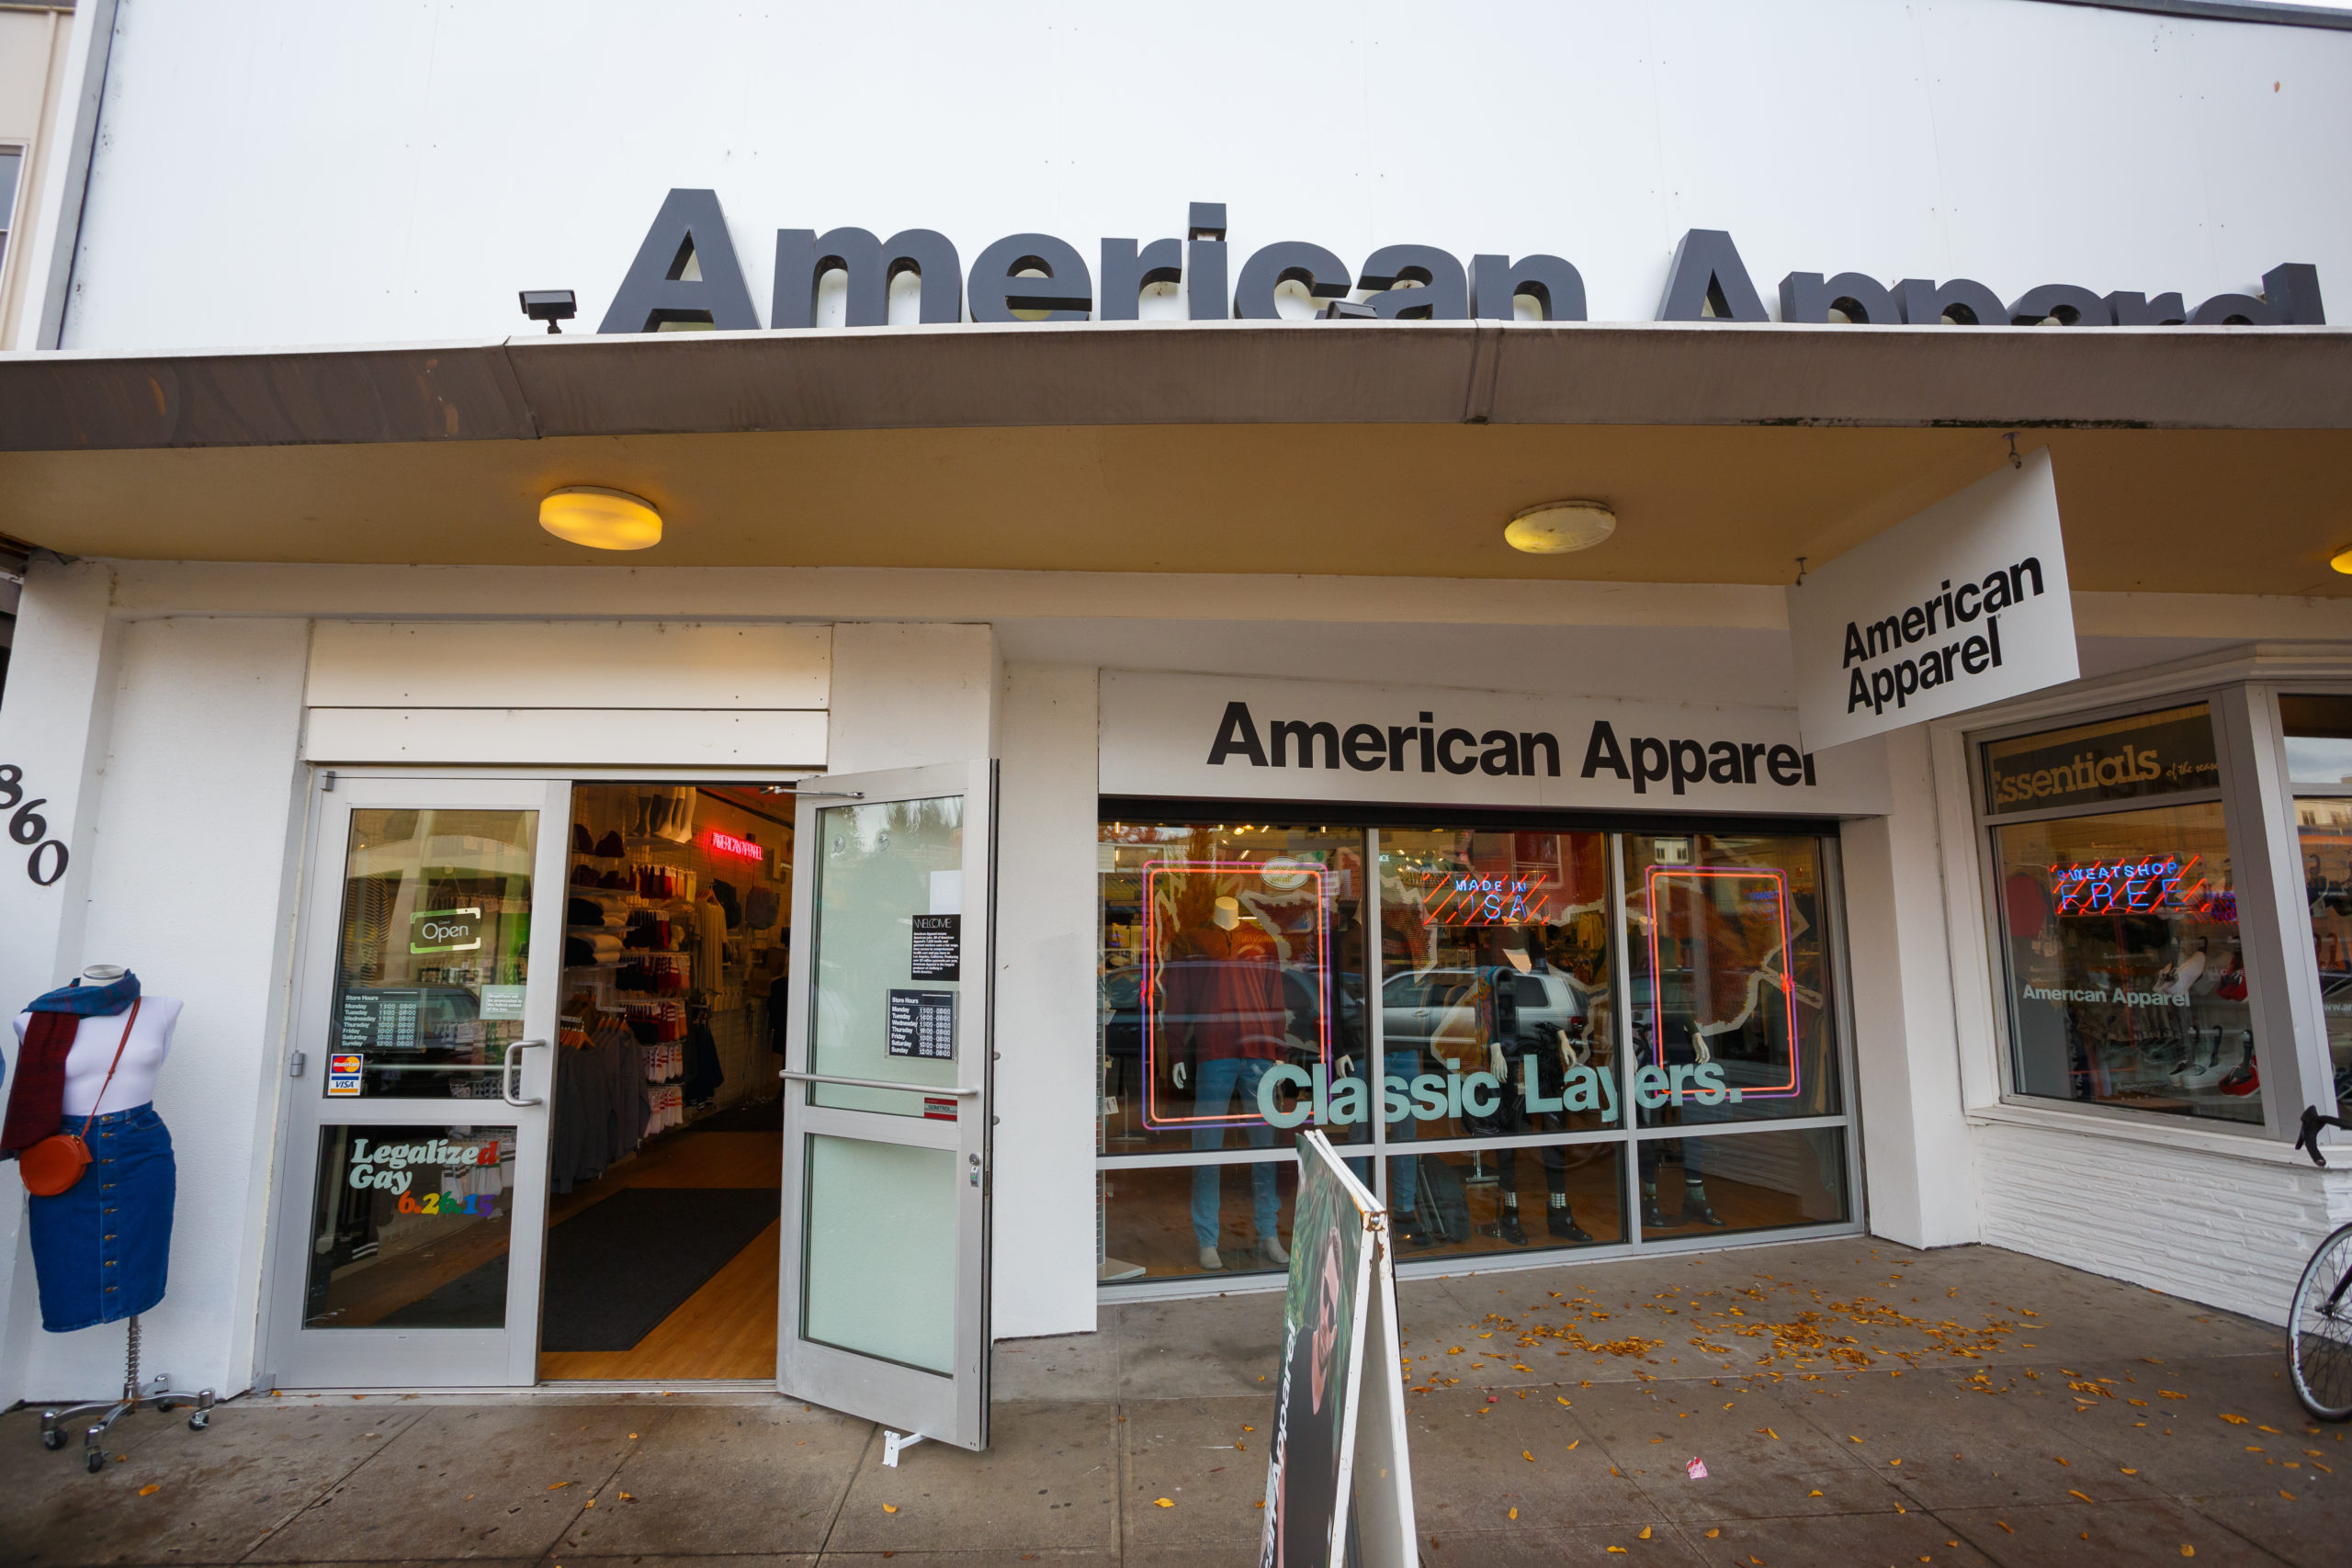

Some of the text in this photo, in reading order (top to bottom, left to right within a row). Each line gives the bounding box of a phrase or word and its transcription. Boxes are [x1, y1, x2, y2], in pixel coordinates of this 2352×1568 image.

[597, 186, 1588, 333] American
[1842, 557, 2044, 669] American
[1847, 615, 2002, 716] Apparel
[1205, 701, 1816, 795] American Apparel
[0, 764, 69, 886] 860
[1455, 879, 1527, 892] MADE IN
[2057, 862, 2177, 882] SWEATSHOP
[1457, 895, 1527, 919] USA
[2060, 879, 2185, 909] FREE
[422, 922, 469, 943] Open
[913, 918, 952, 929] WELCOME
[2022, 984, 2190, 1008] American Apparel
[335, 1080, 354, 1089] VISA
[1257, 1054, 1742, 1129] Classic Layers.
[350, 1138, 499, 1169] Legalized
[349, 1164, 413, 1195] Gay
[398, 1190, 495, 1217] 6.26.15
[1272, 1315, 1296, 1498] Apparel
